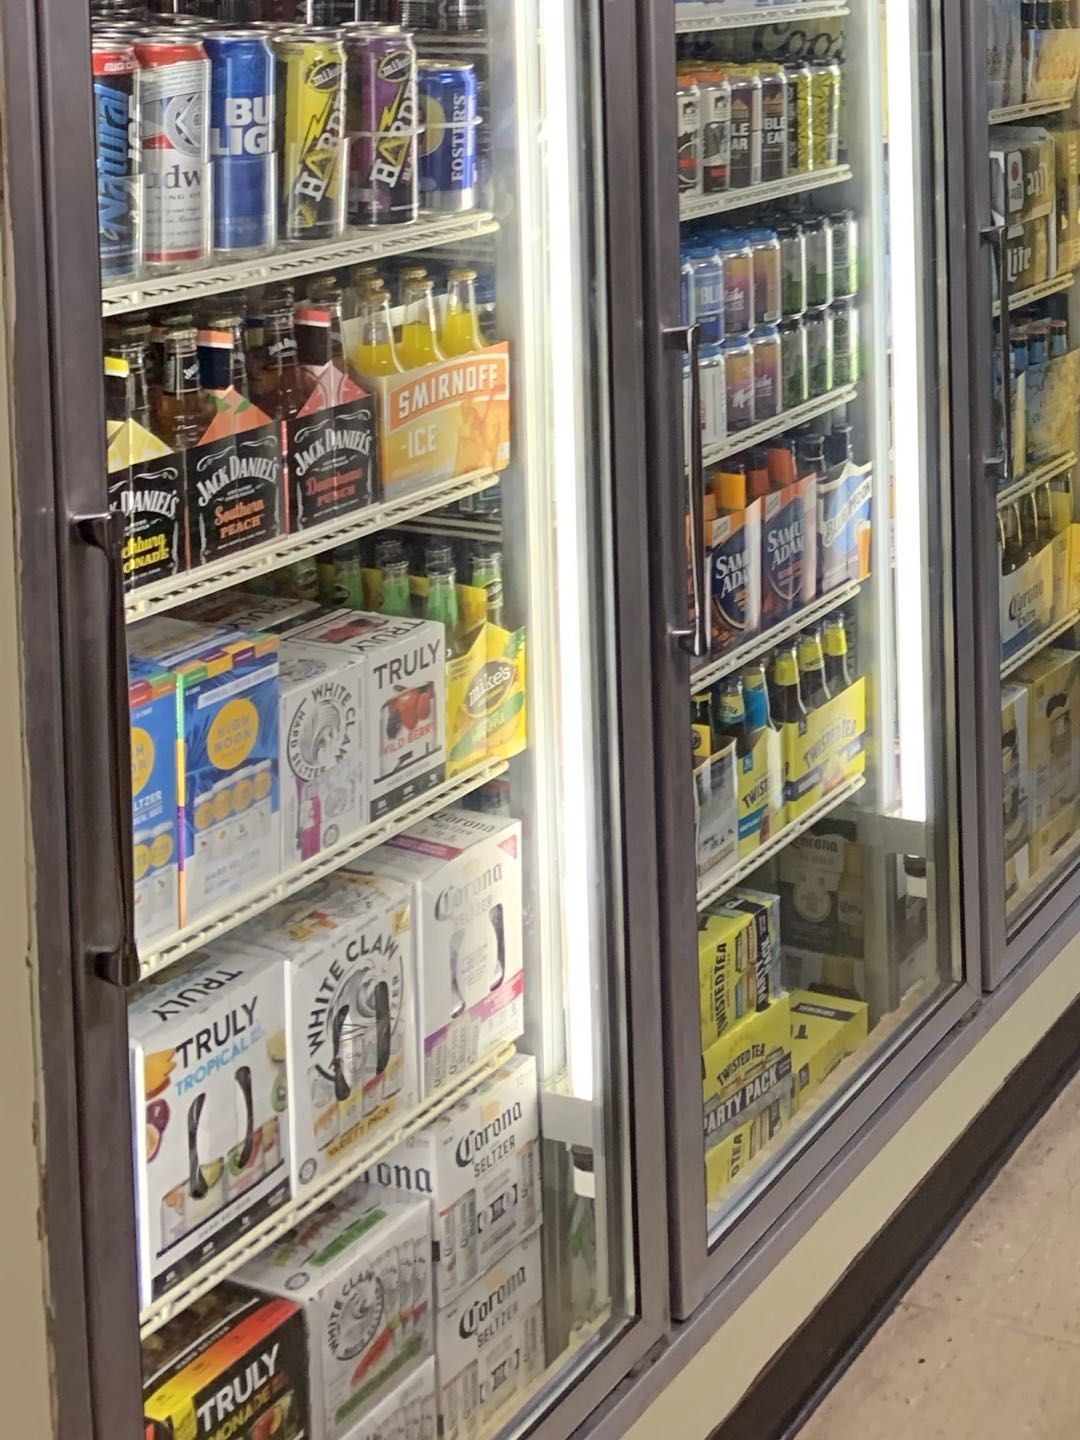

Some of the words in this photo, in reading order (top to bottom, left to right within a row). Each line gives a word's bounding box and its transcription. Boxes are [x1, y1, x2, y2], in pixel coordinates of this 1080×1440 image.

[226, 97, 276, 125] BU
[211, 126, 274, 156] LIG
[1007, 246, 1032, 283] Lite
[398, 363, 498, 420] SMIRNOFF
[293, 439, 326, 477] JACK
[324, 427, 373, 456] DANIEL'S
[407, 424, 438, 459] ICE
[120, 489, 181, 520] DANIEL'S
[196, 465, 230, 507] JACK
[228, 454, 280, 487] DANIEL'S
[219, 513, 264, 540] PEACH
[767, 521, 802, 553] SAMU
[715, 550, 746, 580] SAM
[373, 638, 441, 691] TRULY
[468, 661, 512, 709] mike's
[311, 681, 353, 704] WHITE
[334, 706, 358, 764] CLAW
[742, 777, 770, 810] TWIST
[433, 861, 504, 922] Corona
[715, 941, 728, 969] TEA
[152, 970, 245, 1022] TRULY
[307, 960, 345, 1058] WHITE
[346, 932, 400, 962] CLAW
[176, 995, 259, 1069] TRULY
[174, 1037, 250, 1097] TROPICAL
[716, 1049, 751, 1087] TWISTED
[750, 1042, 766, 1059] TEA
[745, 1065, 778, 1106] PACK
[455, 1101, 523, 1169] Corona
[473, 1134, 517, 1179] SELTZER
[458, 1264, 527, 1340] Corona
[476, 1300, 520, 1350] SELTZER
[196, 1342, 280, 1433] TRULY
